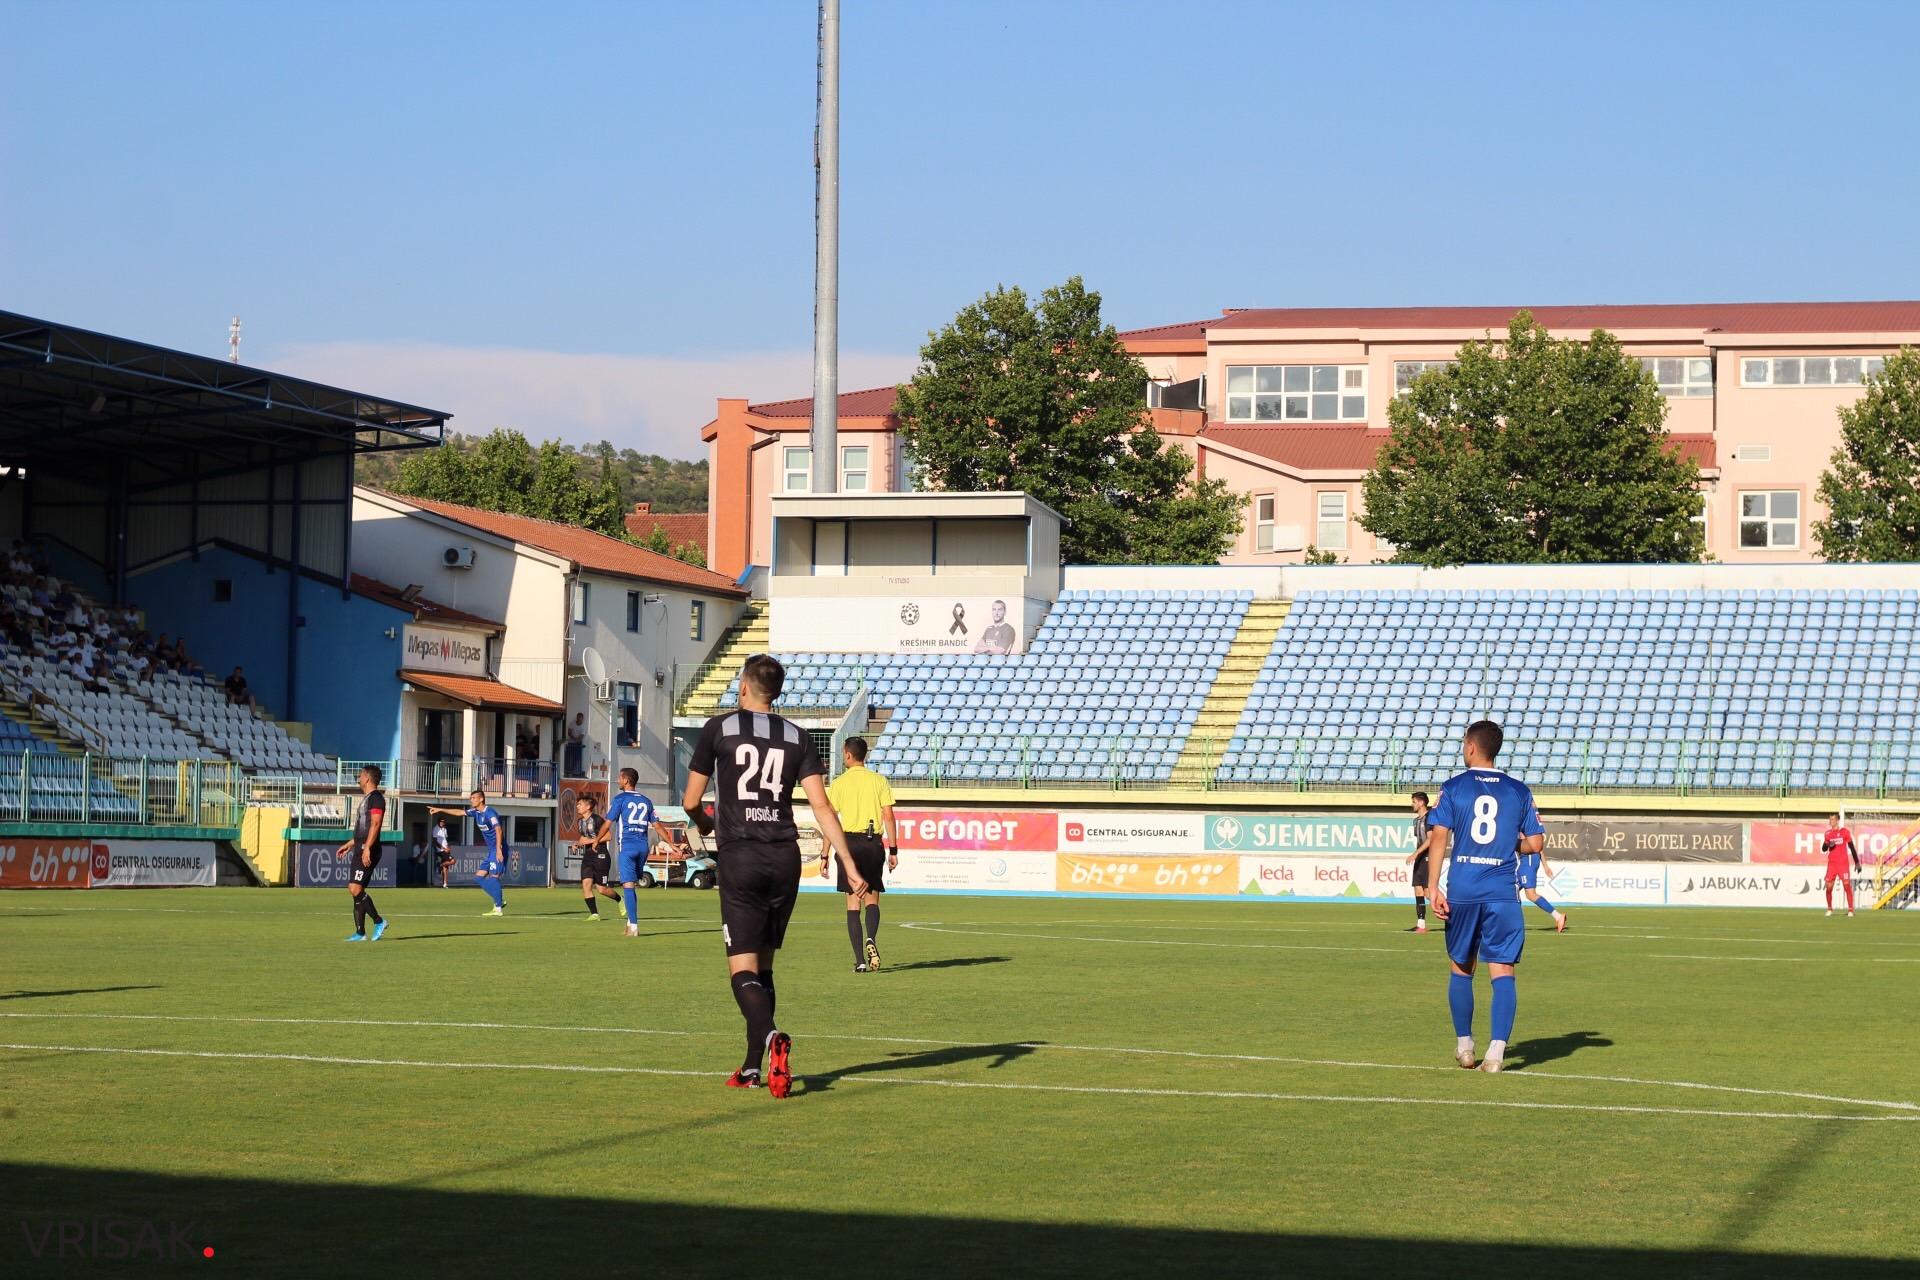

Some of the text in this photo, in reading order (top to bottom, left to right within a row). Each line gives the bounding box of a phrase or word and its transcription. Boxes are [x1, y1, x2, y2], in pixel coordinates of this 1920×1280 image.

[408, 635, 481, 664] Mepas Mepas
[900, 638, 968, 647] KREŠIMIR BANDIĆ
[735, 743, 785, 802] 24
[627, 801, 648, 826] 22
[745, 806, 780, 822] POSUŠJE
[1470, 795, 1498, 845] 8
[1086, 828, 1189, 838] CENTRAL OSIGURANJE
[1252, 823, 1418, 849] SJEMENARNA
[1635, 833, 1735, 851] HOTEL PARK
[111, 856, 201, 870] CENTRAL OSIGURANJE
[354, 869, 364, 881] 13
[1259, 864, 1409, 883] leda leda leda
[1582, 877, 1661, 890] EMERUS
[1699, 876, 1782, 891] JABUKA.TV
